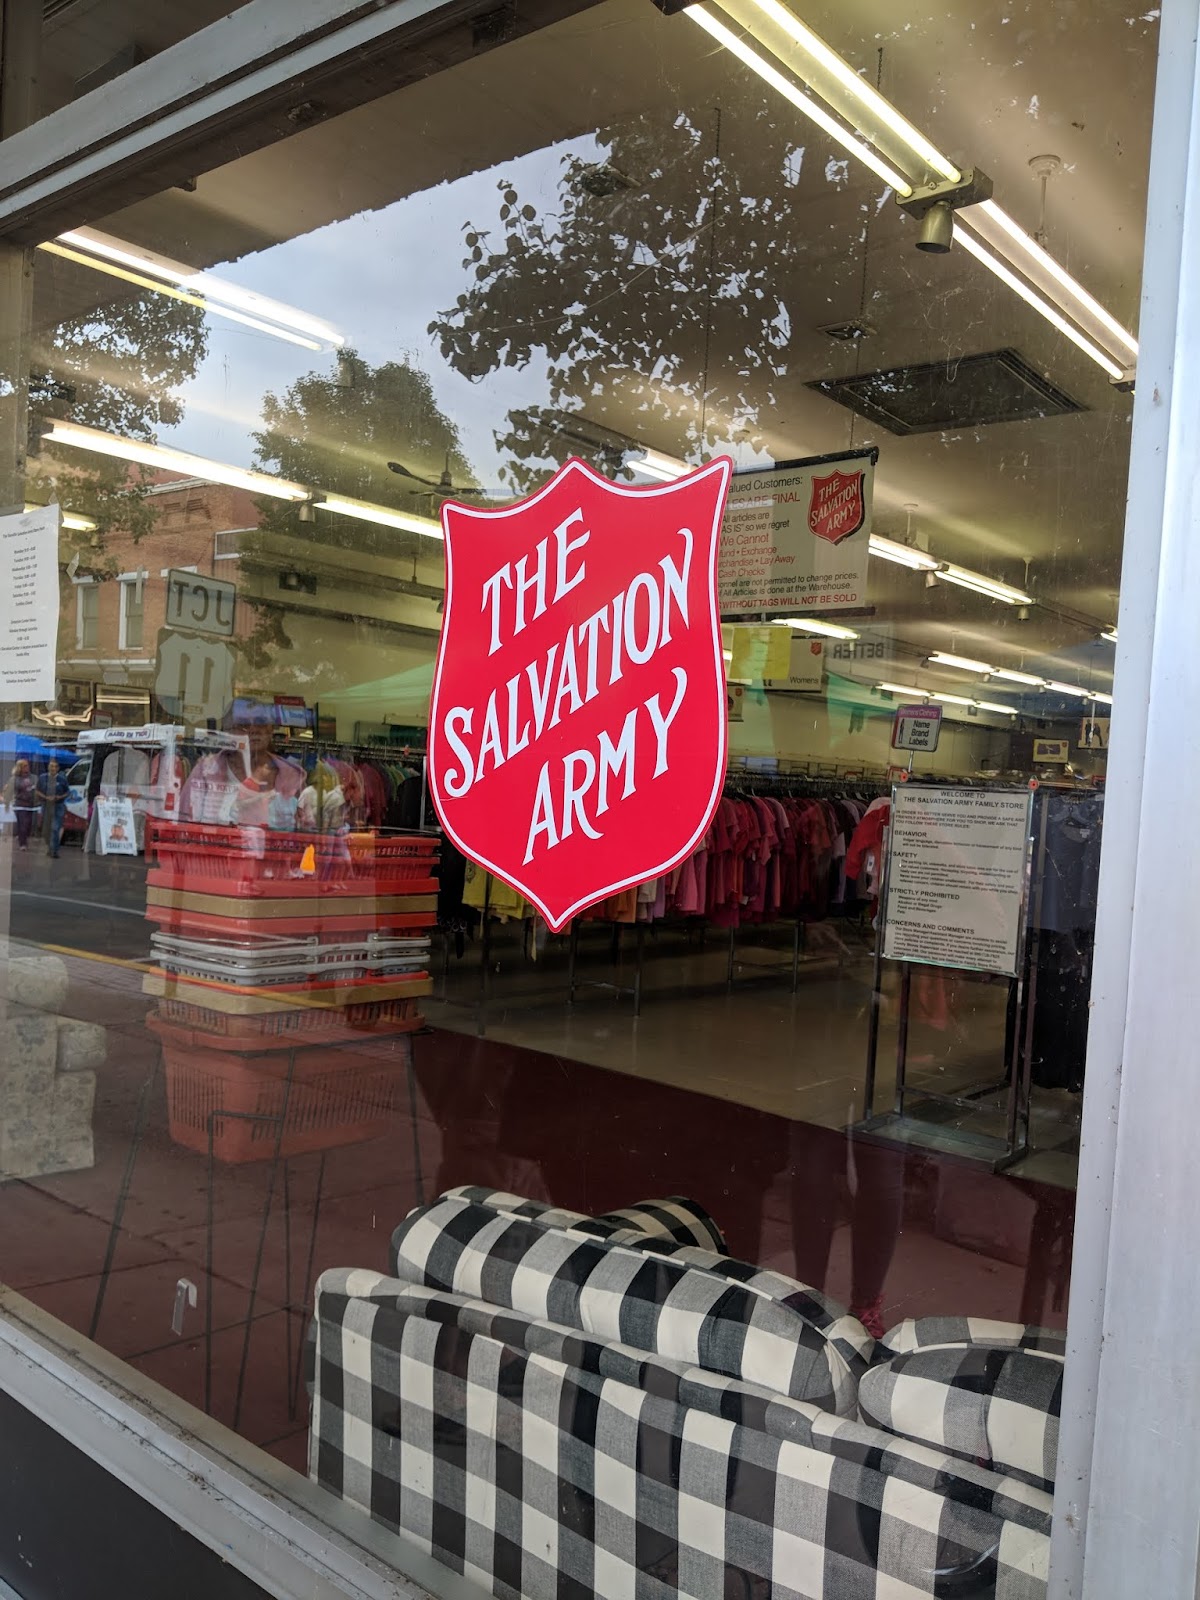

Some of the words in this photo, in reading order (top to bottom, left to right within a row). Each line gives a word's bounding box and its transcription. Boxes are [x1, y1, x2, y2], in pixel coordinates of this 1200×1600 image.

[729, 481, 752, 493] alued
[754, 476, 803, 490] Customers:
[819, 478, 840, 502] THE
[772, 491, 800, 504] FINAL
[810, 480, 858, 527] SALVATION
[732, 512, 756, 523] articles
[758, 512, 770, 520] are
[826, 500, 856, 534] ARMY
[769, 520, 790, 531] regret
[737, 533, 769, 545] Cannot
[741, 546, 777, 556] Exchange
[774, 555, 795, 565] Away
[738, 568, 766, 577] Checks
[481, 507, 591, 656] THE
[764, 575, 797, 587] permitted
[798, 575, 805, 583] to
[806, 572, 833, 583] change
[835, 571, 859, 582] prices.
[733, 588, 758, 596] Articles
[767, 586, 785, 594] done
[786, 585, 794, 593] at
[795, 584, 807, 592] the
[808, 581, 853, 592] Warehouse.
[721, 600, 757, 609] WITHOUT
[758, 599, 779, 607] TAGS
[780, 597, 800, 606] WILL
[801, 596, 818, 605] NOT
[820, 595, 832, 603] BE
[833, 593, 857, 603] SOLD
[443, 528, 694, 798] SALVATION
[789, 676, 819, 685] Womens
[913, 720, 931, 729] Name
[911, 729, 930, 737] Brand
[909, 737, 929, 746] Labels
[522, 666, 687, 866] ARMY
[940, 790, 974, 798] WELCOME
[916, 797, 953, 805] SALVATION
[1000, 801, 1024, 809] STORE
[894, 829, 927, 837] BEHAVIOR
[892, 850, 917, 858] SAFETY
[889, 887, 918, 895] STRICTLY
[920, 890, 959, 900] PROHIBITED
[886, 918, 921, 928] CONCERNS
[921, 922, 936, 930] AND
[937, 924, 974, 934] COMMENTS
